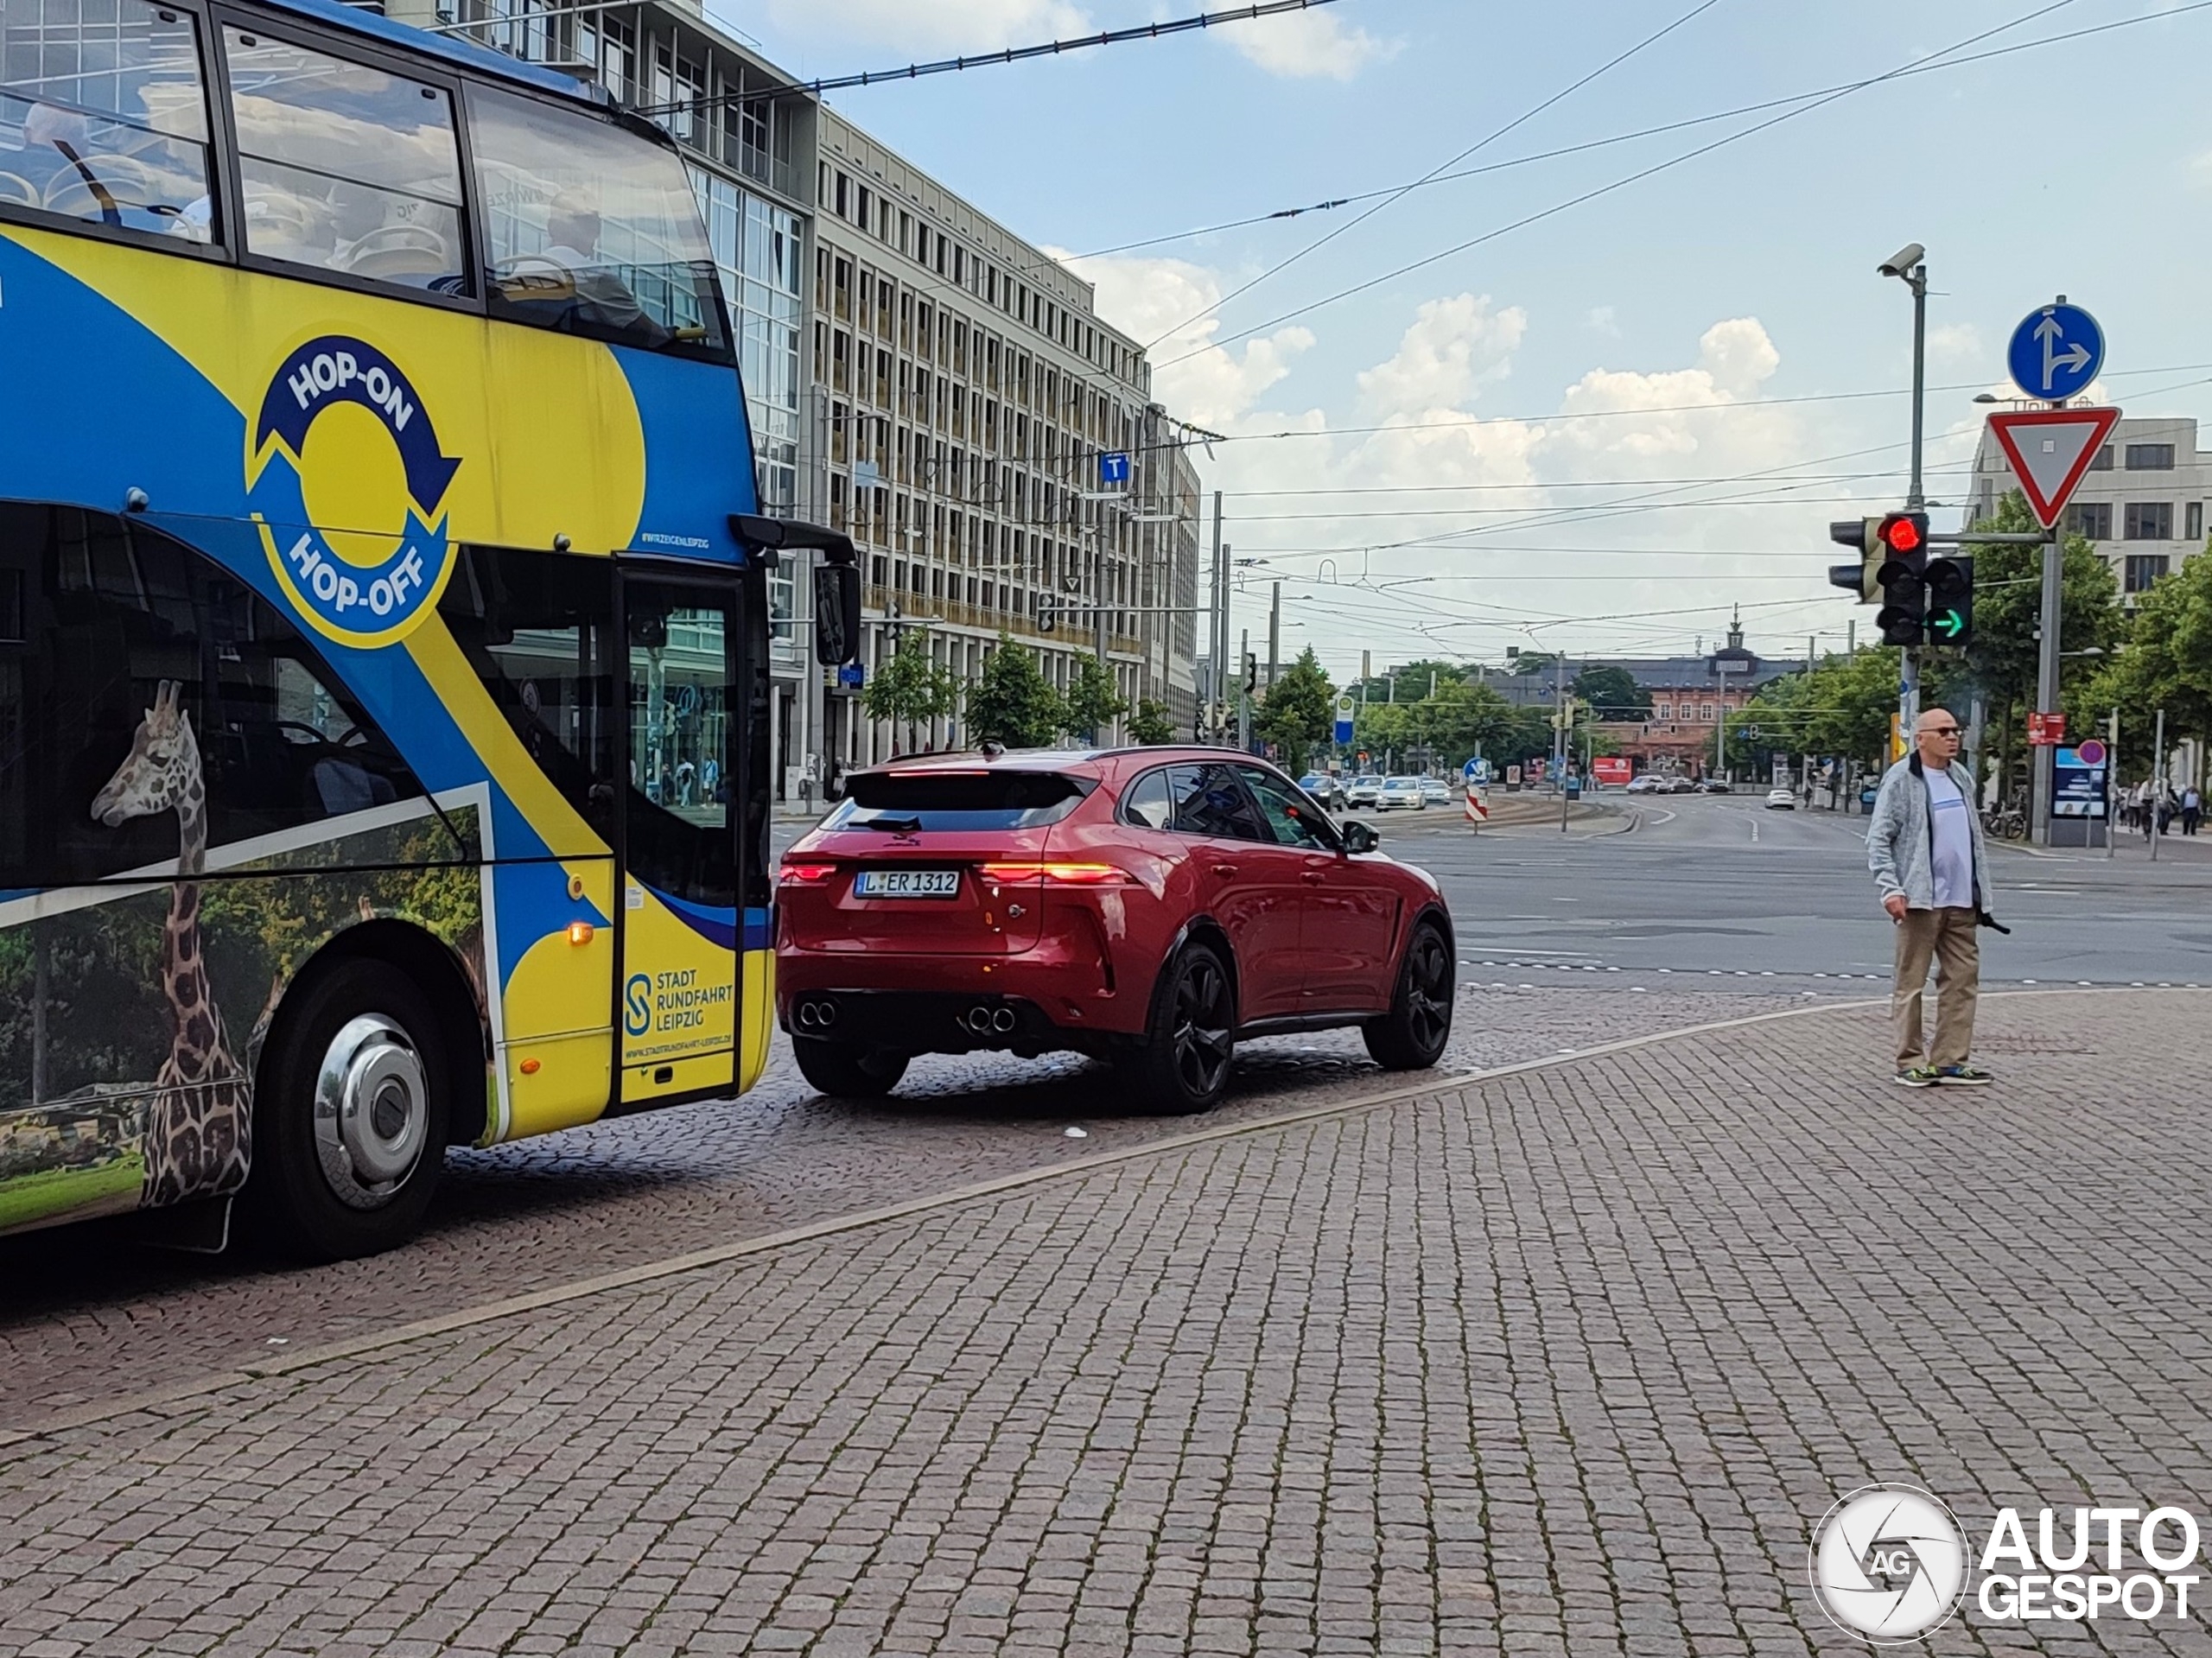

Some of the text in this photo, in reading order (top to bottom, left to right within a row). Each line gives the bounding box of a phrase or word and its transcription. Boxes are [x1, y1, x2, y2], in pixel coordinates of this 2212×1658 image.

[288, 351, 414, 432] HOP-ON
[1107, 458, 1122, 478] T
[289, 532, 423, 616] HOP-OFF
[865, 873, 957, 892] L ER 1312
[657, 969, 697, 989] STADT
[657, 985, 734, 1011] RUNDFAHRT
[656, 1009, 704, 1032] LEIPZIG
